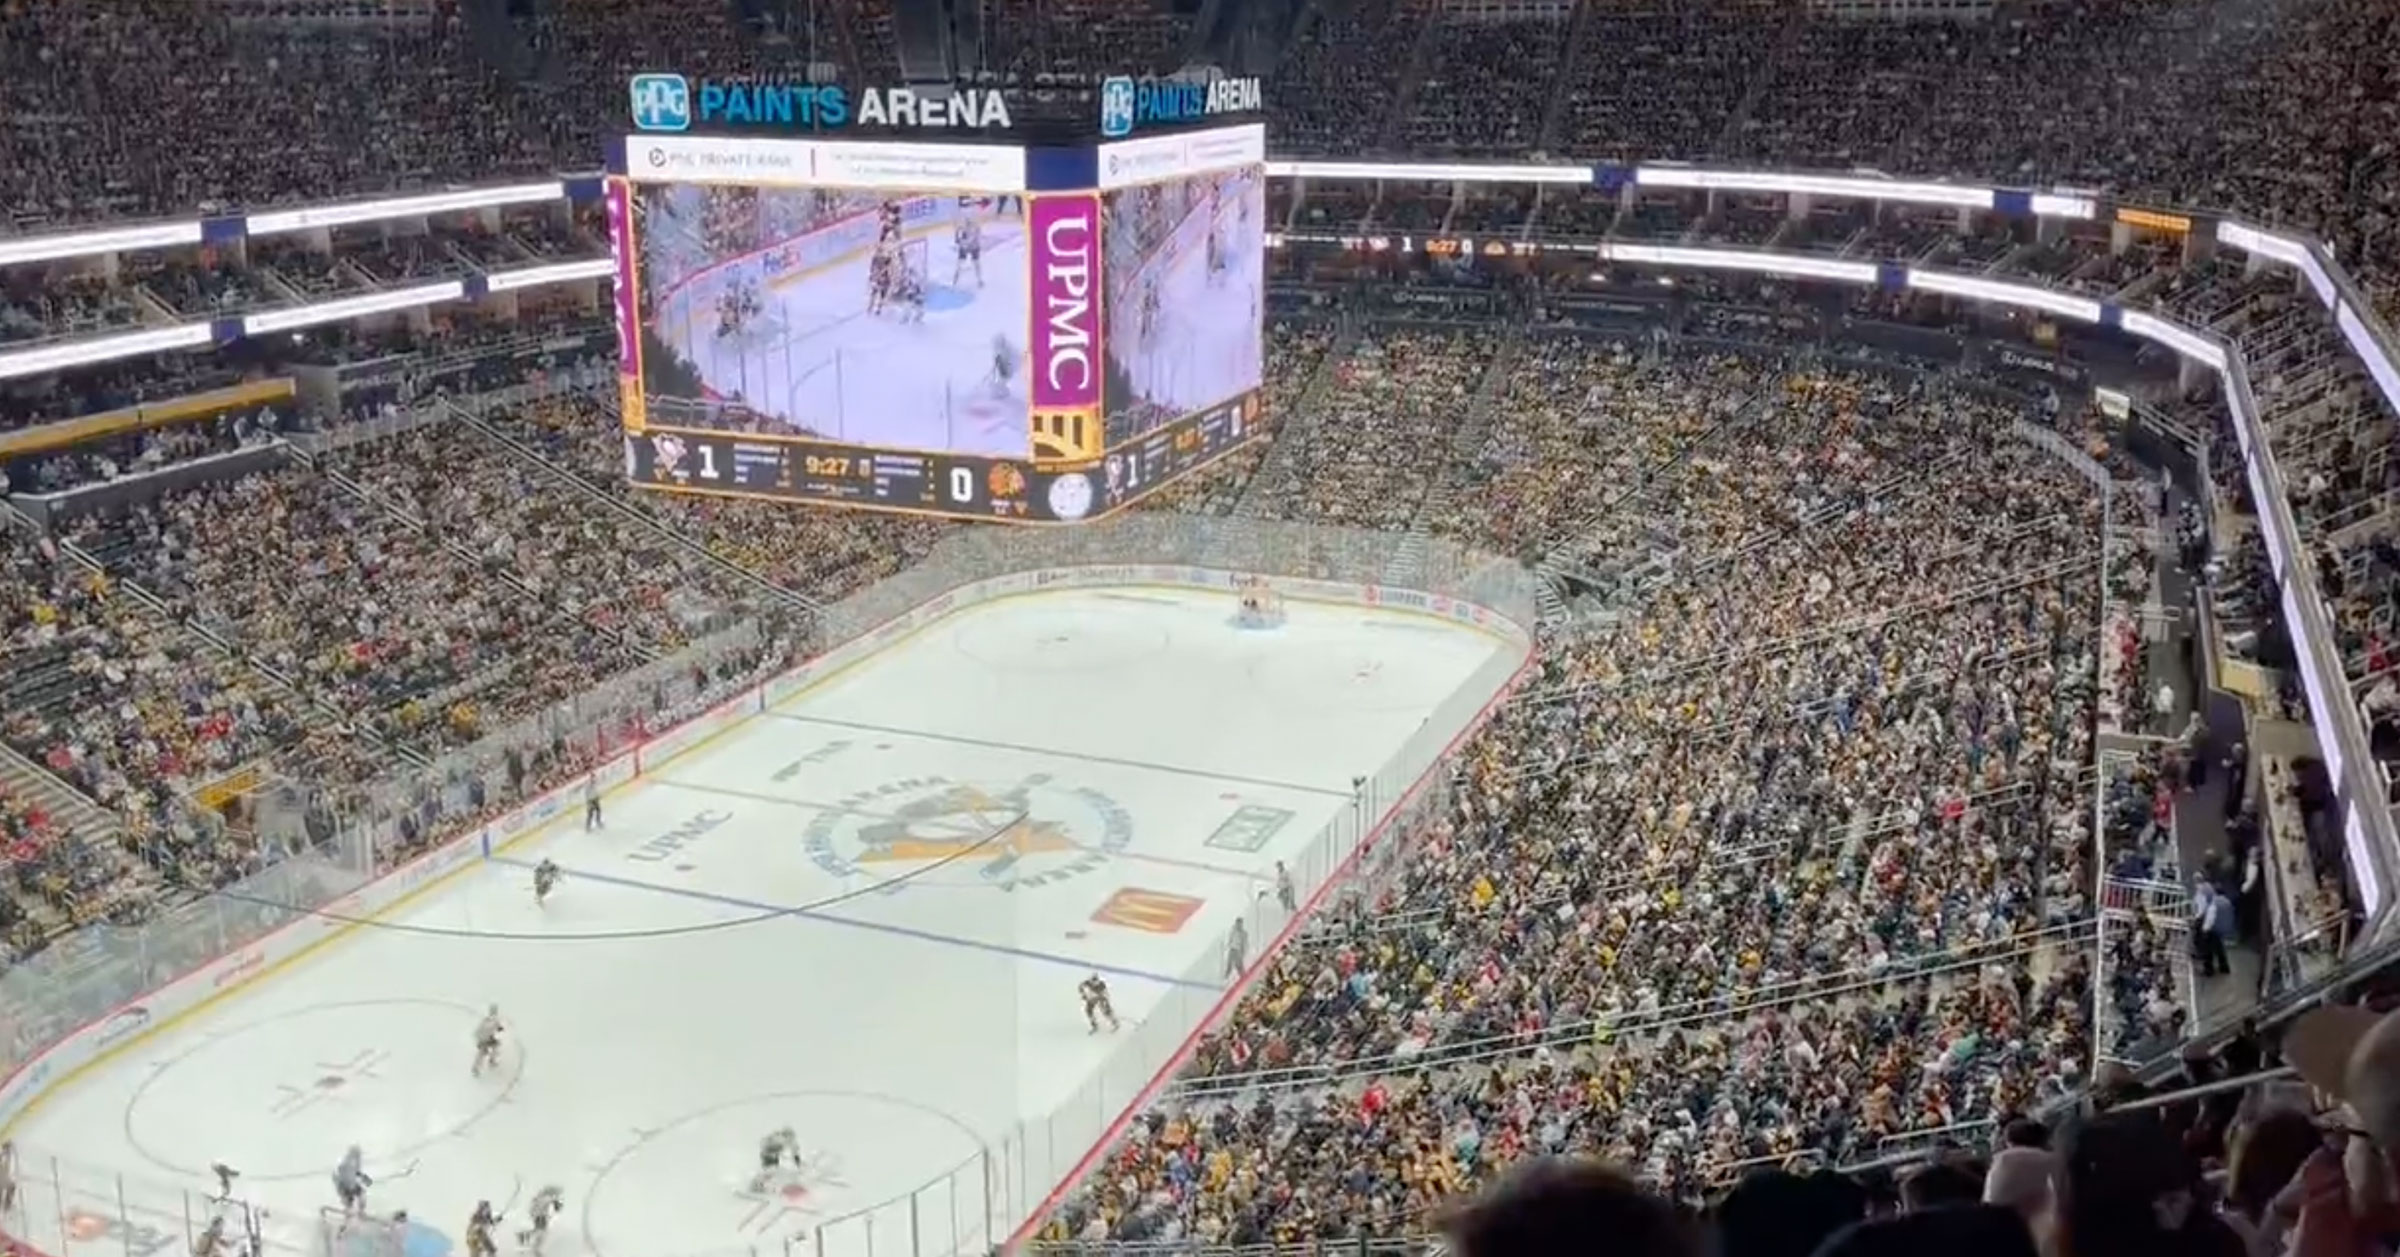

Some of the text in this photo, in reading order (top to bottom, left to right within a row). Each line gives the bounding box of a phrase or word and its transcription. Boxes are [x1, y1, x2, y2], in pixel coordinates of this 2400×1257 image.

[637, 81, 1012, 127] PPG PAINTS ARENA
[1205, 77, 1262, 114] ARENA
[1403, 237, 1413, 252] 1
[1047, 213, 1089, 390] UPMC
[698, 445, 719, 478] 1
[806, 455, 849, 476] 9:27
[950, 467, 973, 502] 0
[628, 809, 734, 861] UPMC
